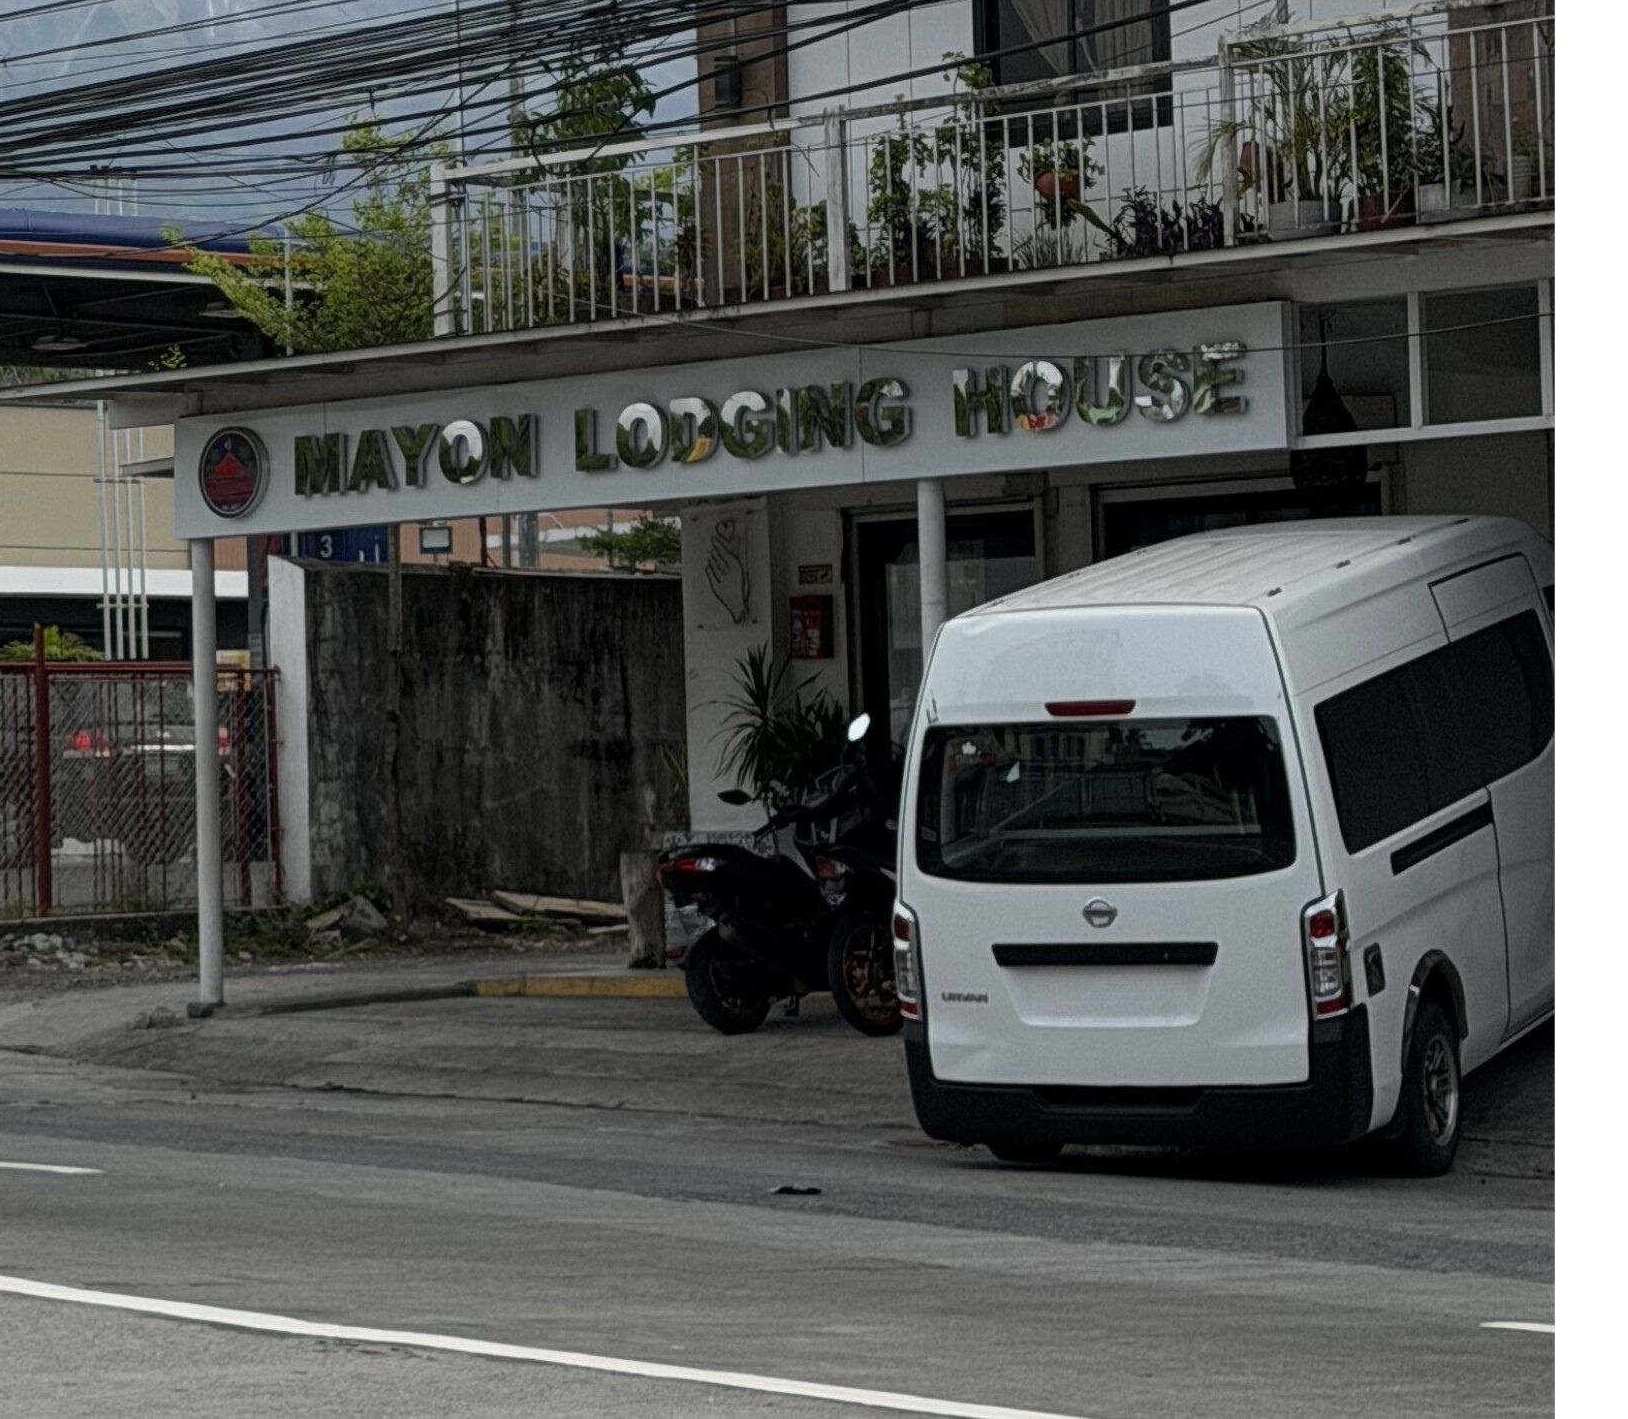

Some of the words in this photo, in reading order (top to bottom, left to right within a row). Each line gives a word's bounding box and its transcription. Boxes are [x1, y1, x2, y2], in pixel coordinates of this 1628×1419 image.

[294, 413, 540, 497] MAYON
[574, 377, 914, 472] LODGING
[953, 341, 1249, 438] HOUSE
[320, 535, 333, 558] 3
